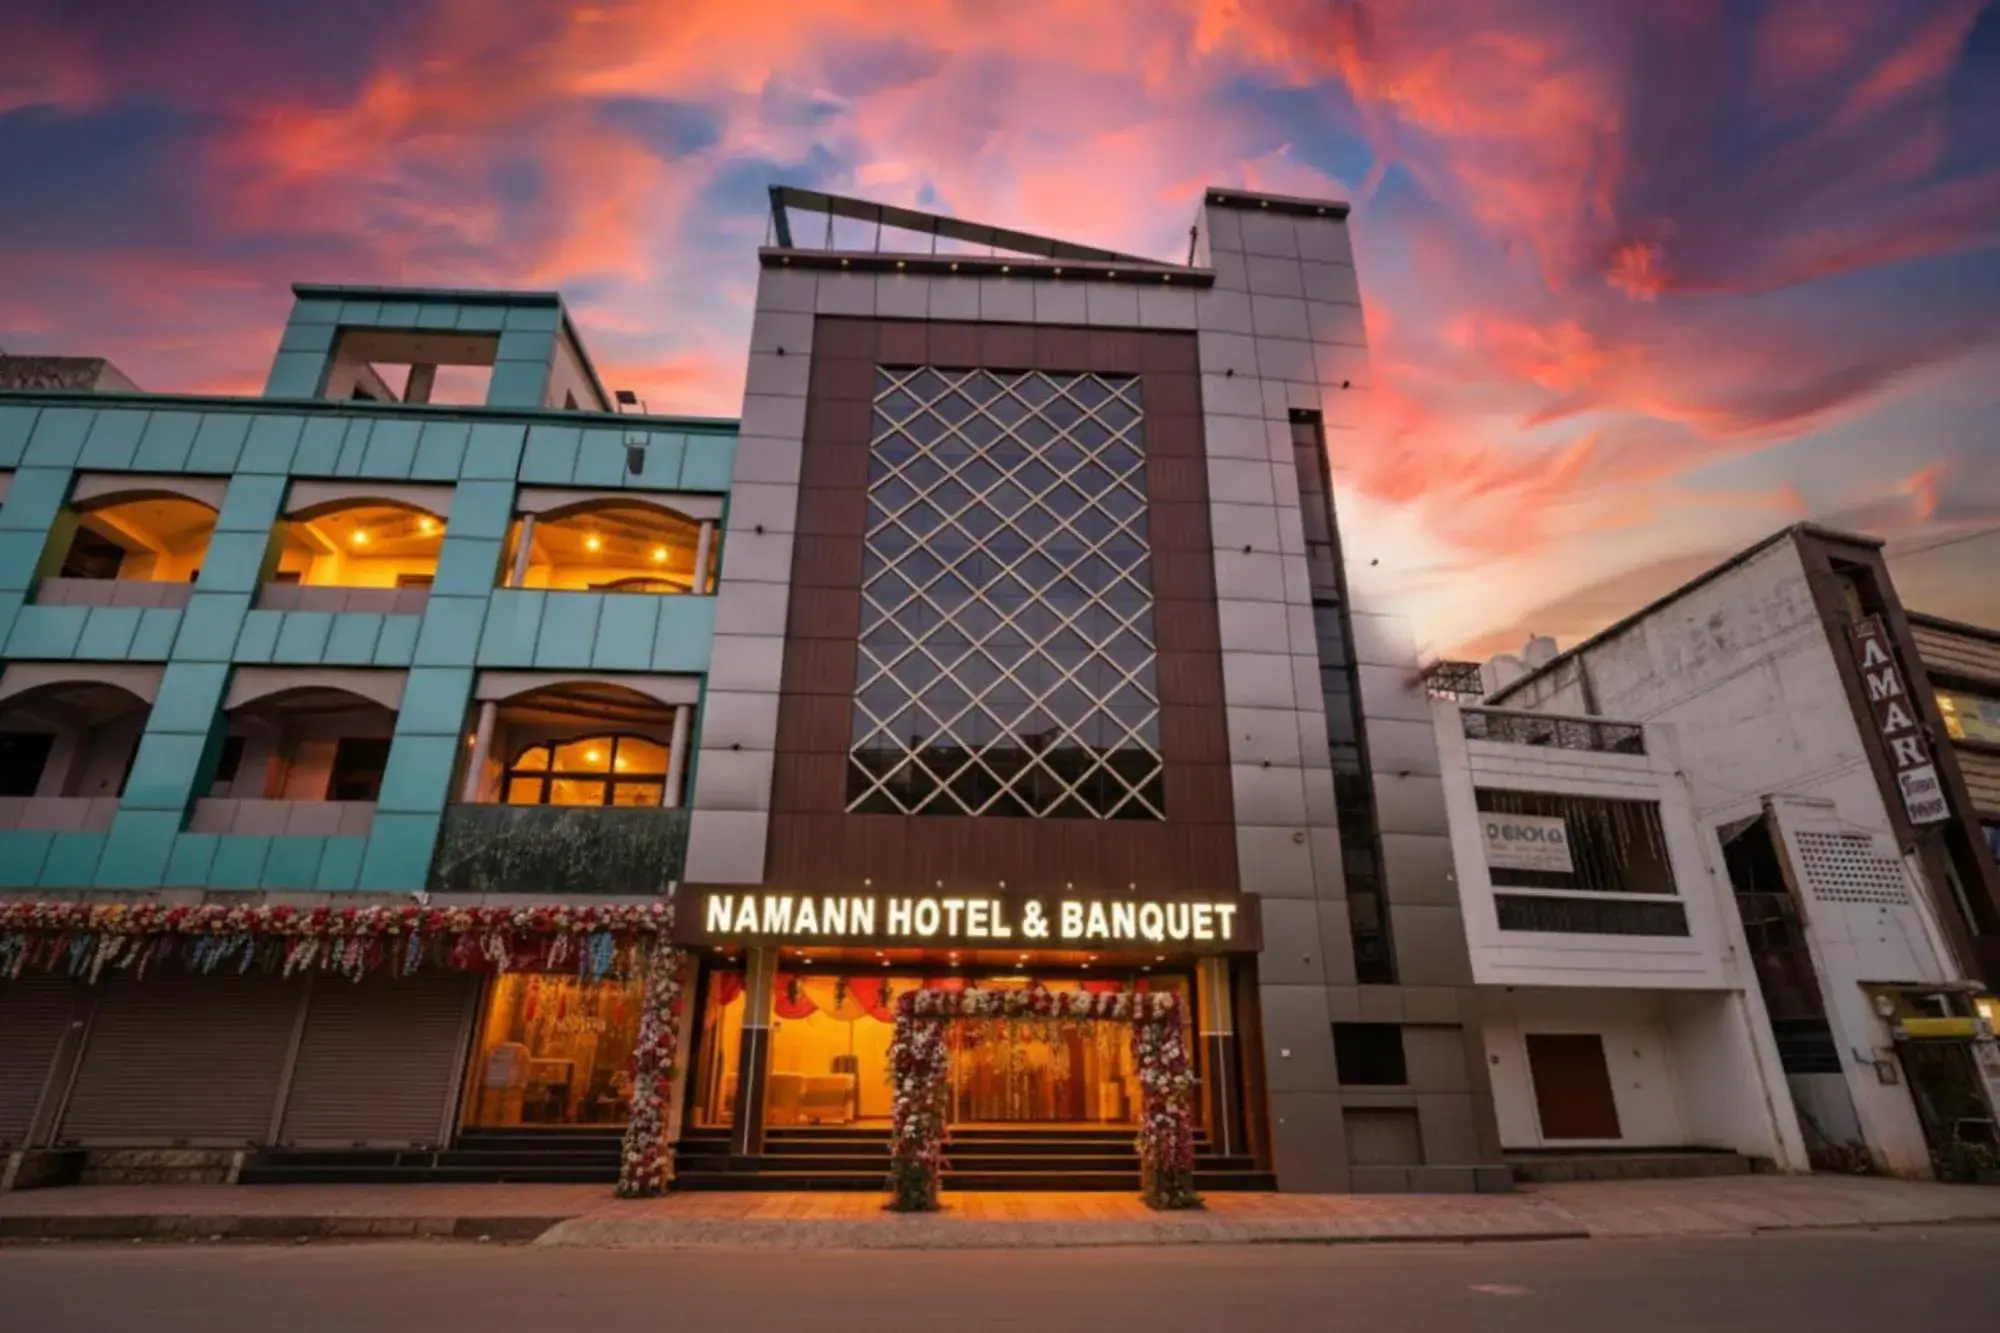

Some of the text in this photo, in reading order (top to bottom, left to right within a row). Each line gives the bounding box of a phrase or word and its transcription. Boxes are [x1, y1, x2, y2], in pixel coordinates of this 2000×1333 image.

[1863, 638, 1927, 768] AMAR
[706, 895, 1237, 942] NAMANN HOTEL & BANQUET
